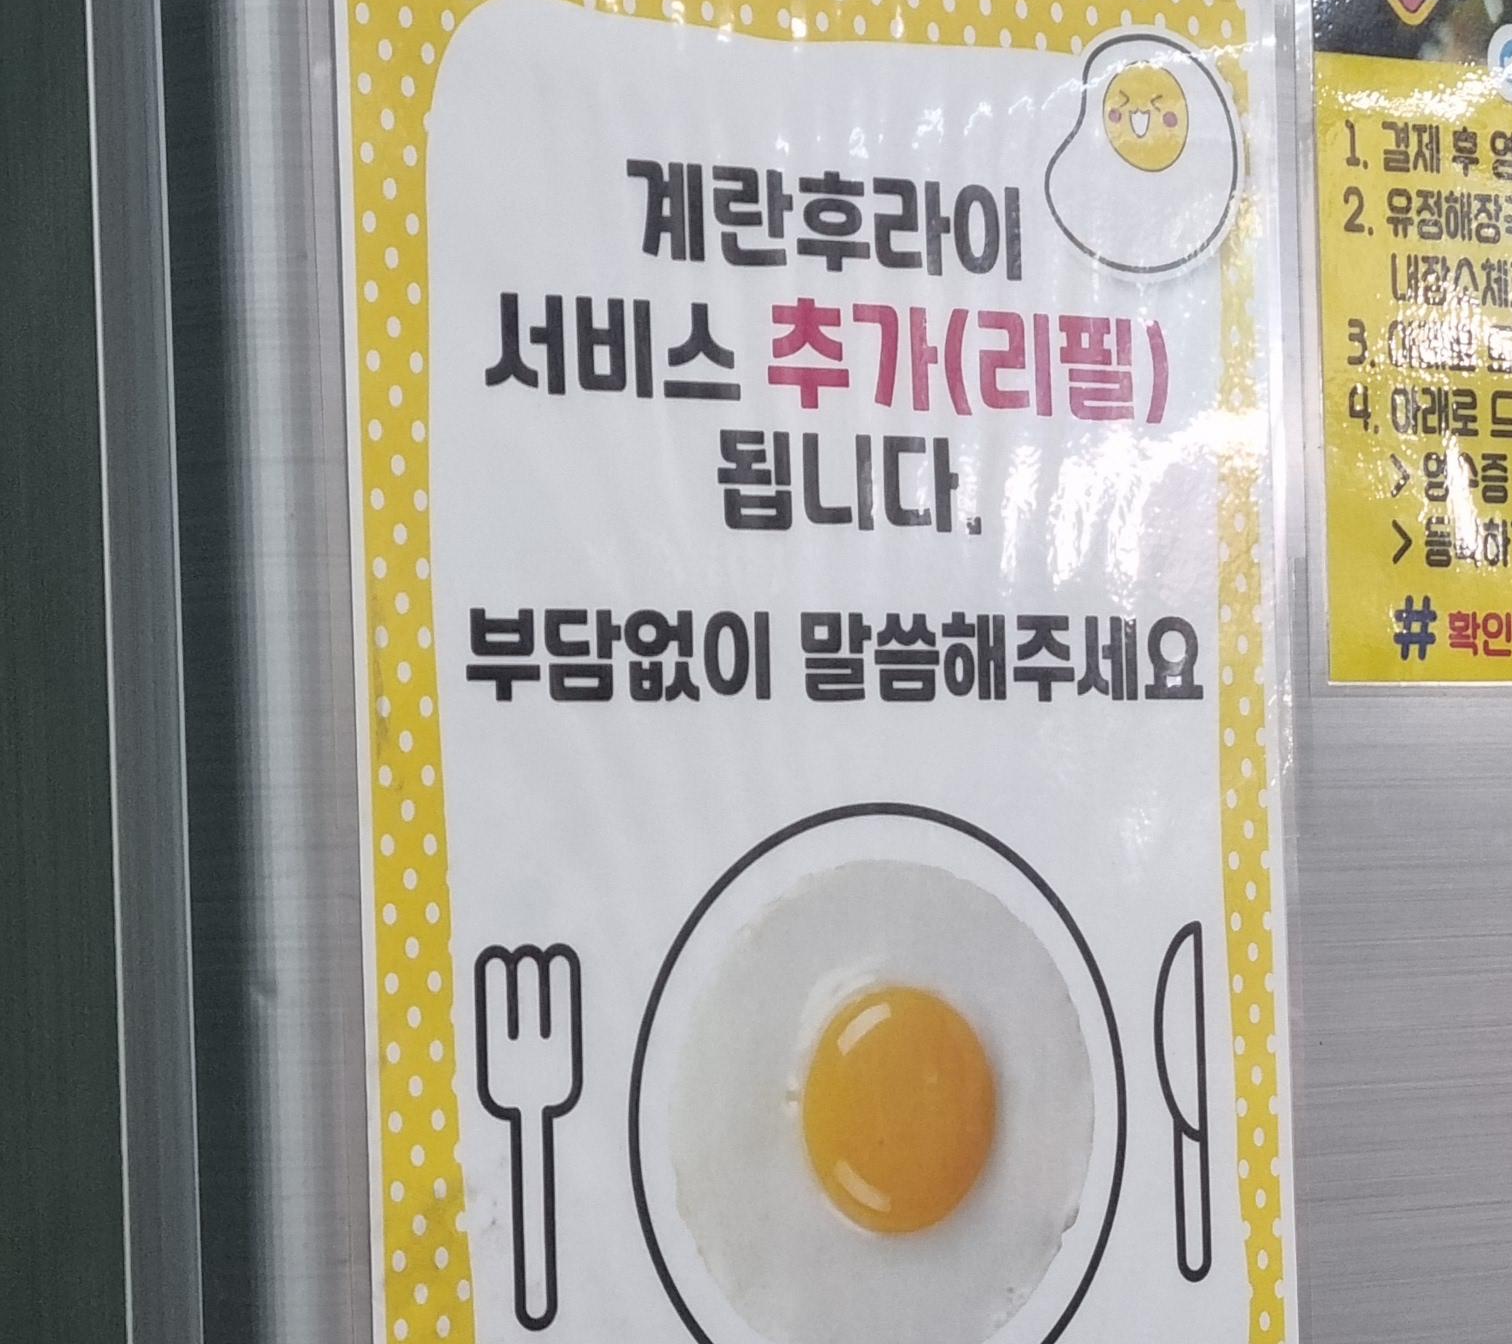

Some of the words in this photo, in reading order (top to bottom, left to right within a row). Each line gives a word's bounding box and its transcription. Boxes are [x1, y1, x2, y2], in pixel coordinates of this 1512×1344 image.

[1345, 120, 1368, 169] 1.
[1382, 122, 1440, 173] 결제
[1452, 126, 1479, 177] 후
[626, 158, 1023, 282] 계란후라이
[1343, 186, 1374, 237] 2.
[485, 291, 742, 402] 서비스
[767, 297, 1170, 425] 추가(리필)
[1347, 318, 1376, 367] 3.
[1350, 385, 1379, 435] 4.
[1391, 387, 1479, 437] 아래로
[717, 428, 982, 535] 됩니다.
[466, 606, 772, 703] 부담없이
[799, 610, 1204, 703] 말씀해주세요
[1448, 610, 1512, 657] 확인
